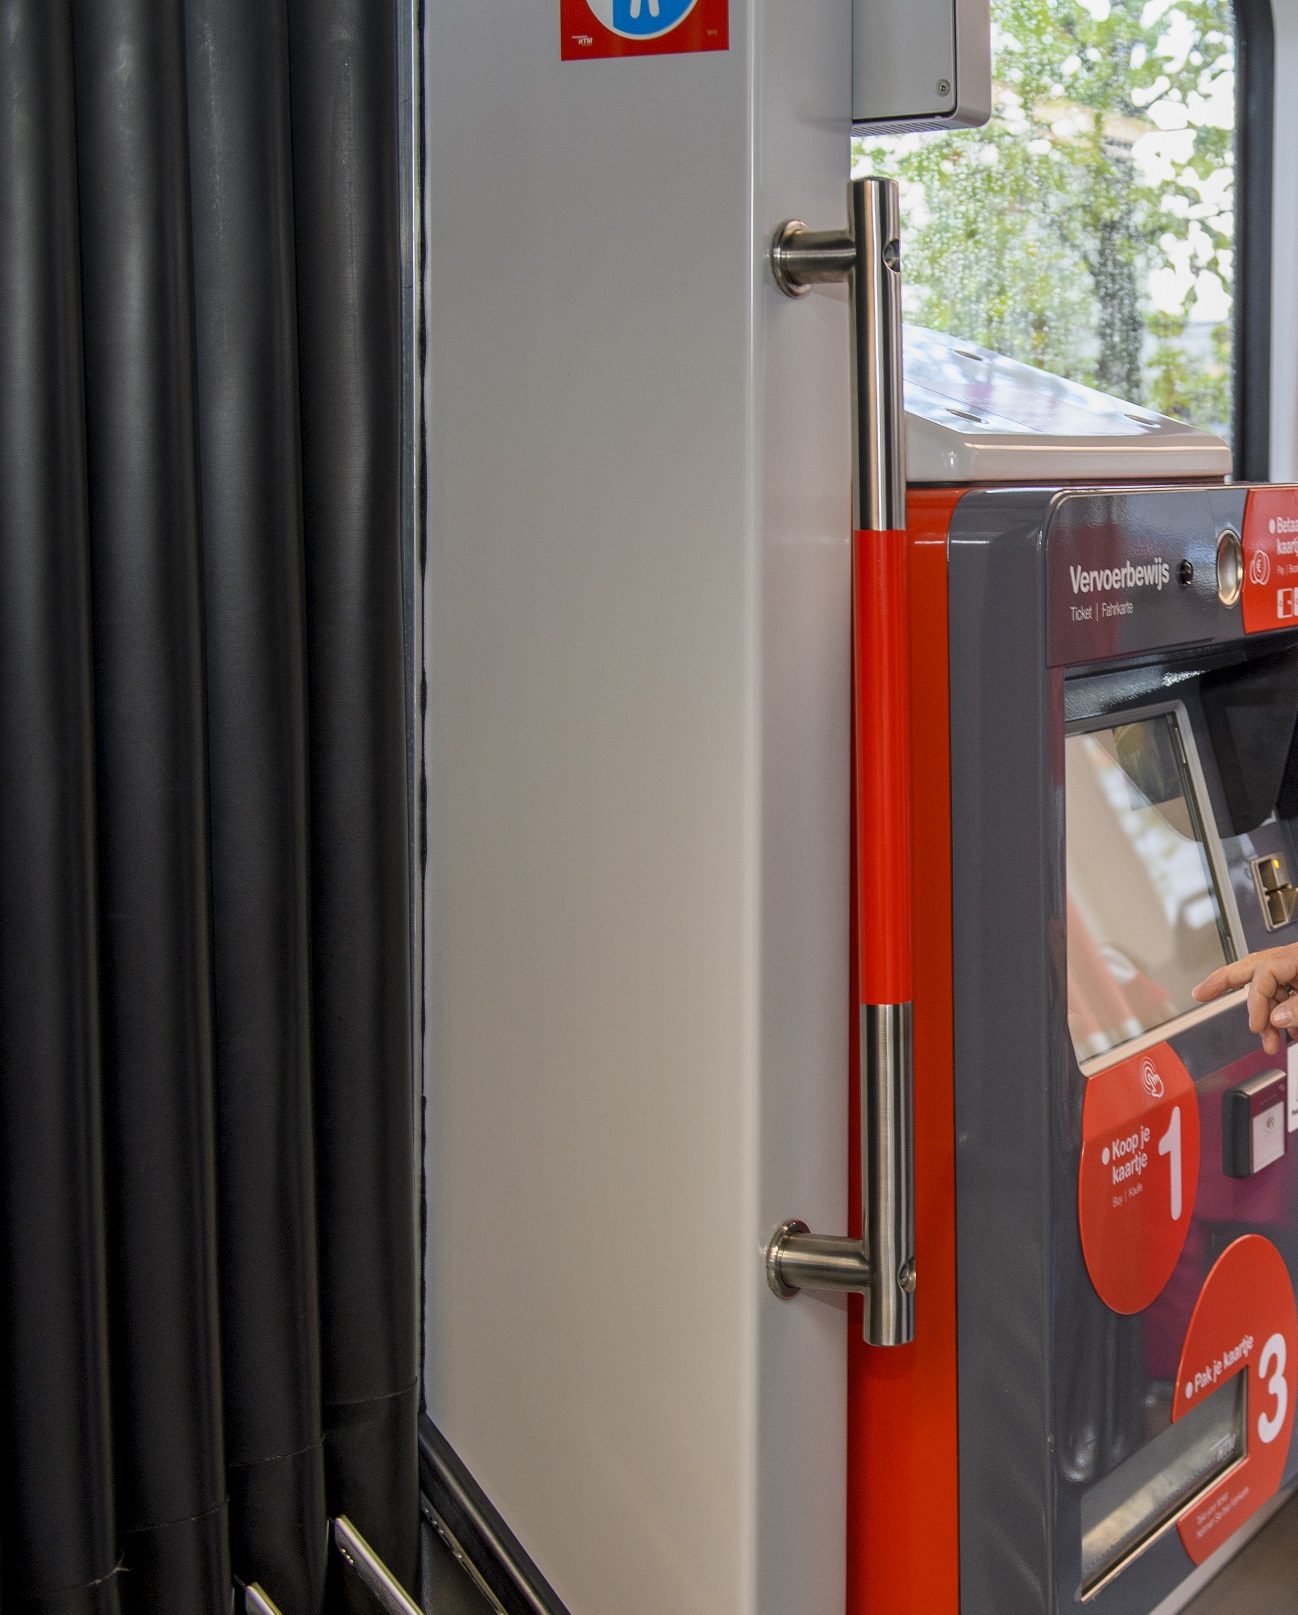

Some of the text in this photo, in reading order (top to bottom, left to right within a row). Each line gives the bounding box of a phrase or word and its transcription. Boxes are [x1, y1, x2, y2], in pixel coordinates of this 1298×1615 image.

[1070, 557, 1170, 594] Vervoerbewijs
[1070, 600, 1133, 621] Ticket Fahrkarte
[1112, 1125, 1151, 1160] Koop je
[1112, 1151, 1148, 1185] kaartje
[1158, 1106, 1182, 1220] 1
[1194, 1334, 1254, 1393] Pak je kaartje
[1258, 1333, 1288, 1444] 3
